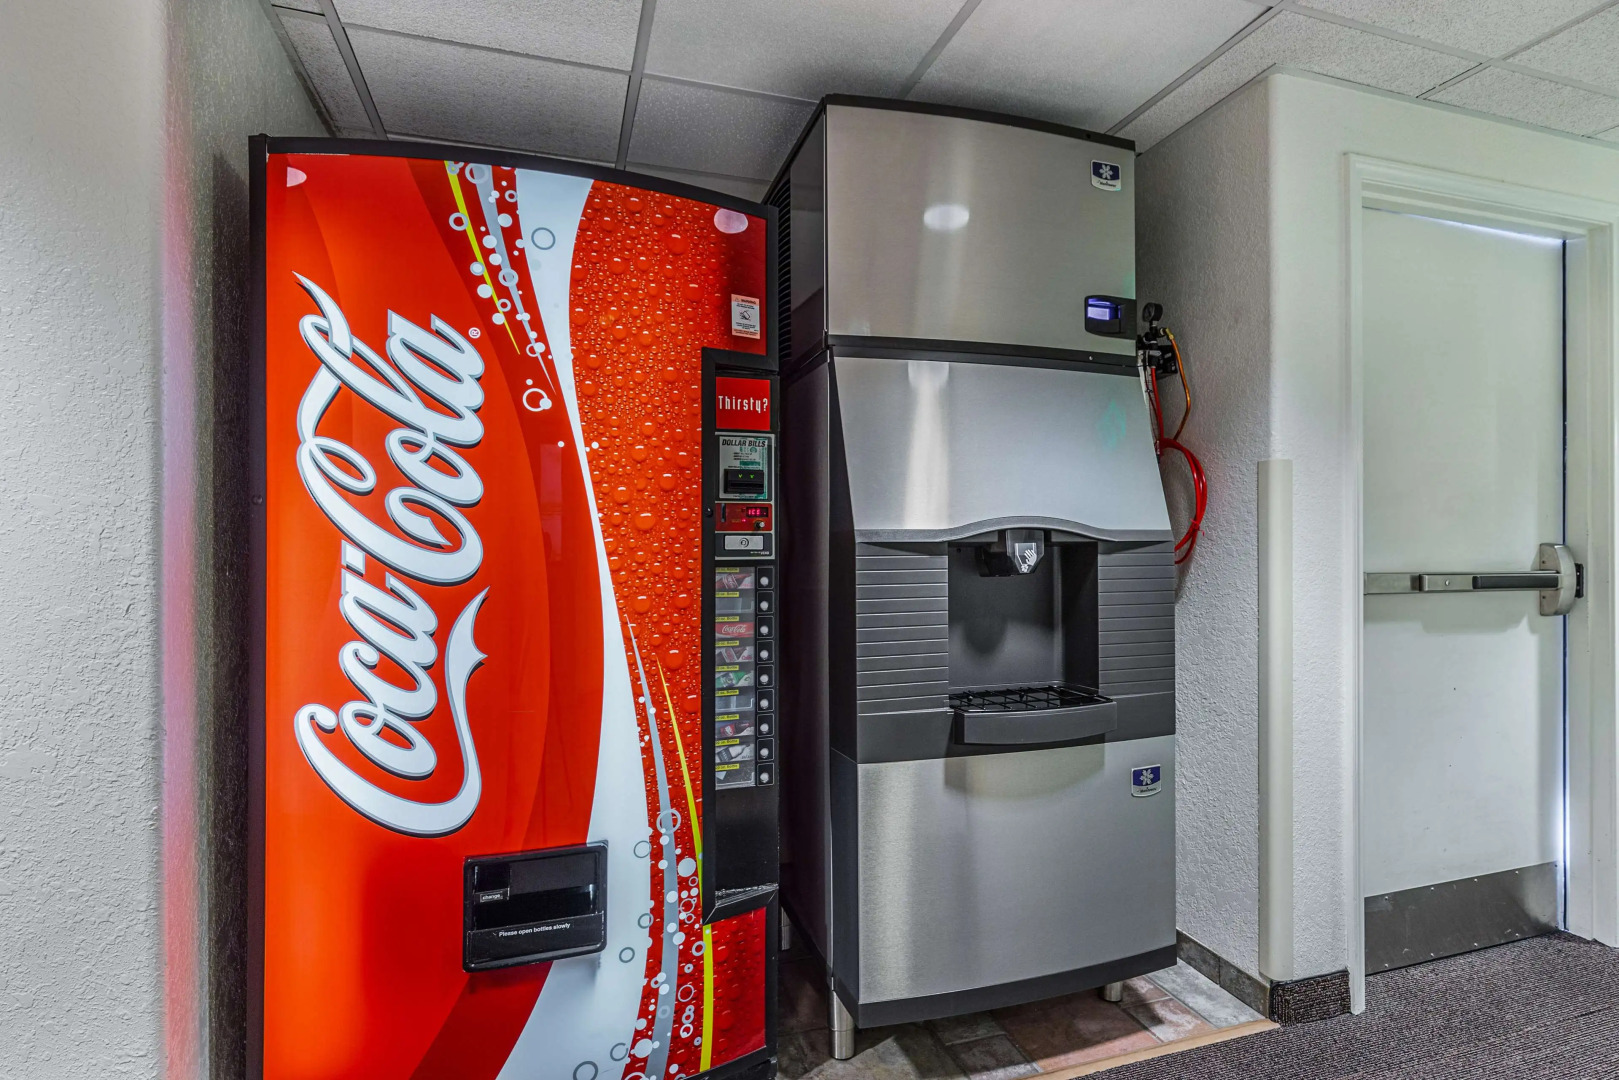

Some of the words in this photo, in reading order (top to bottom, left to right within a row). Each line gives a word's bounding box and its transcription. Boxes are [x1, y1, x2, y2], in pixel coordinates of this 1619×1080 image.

[718, 395, 768, 413] Thirsty?
[721, 438, 747, 447] DOLLAR
[291, 269, 490, 839] Coca-Cola
[533, 925, 552, 933] bottles
[552, 922, 571, 930] slowly
